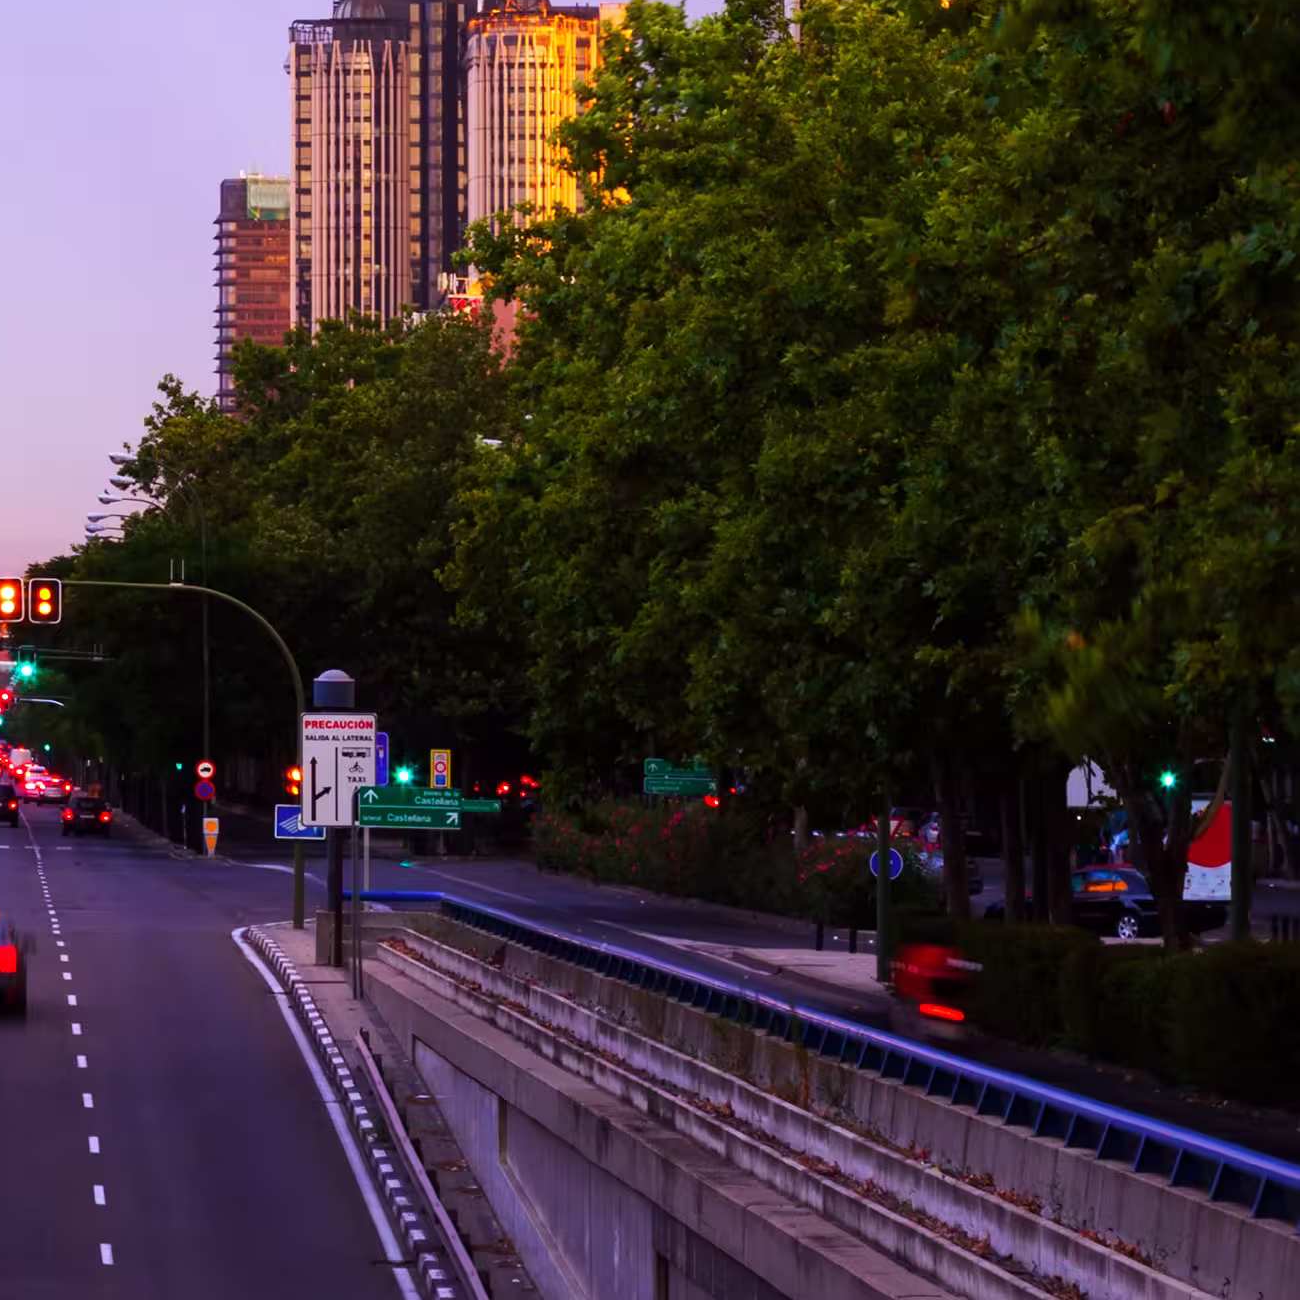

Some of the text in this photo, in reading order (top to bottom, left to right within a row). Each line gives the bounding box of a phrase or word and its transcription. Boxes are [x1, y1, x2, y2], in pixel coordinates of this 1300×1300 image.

[304, 719, 373, 729] PRECAUCIÓN
[414, 795, 459, 806] Castellana
[387, 813, 431, 823] Castellana
